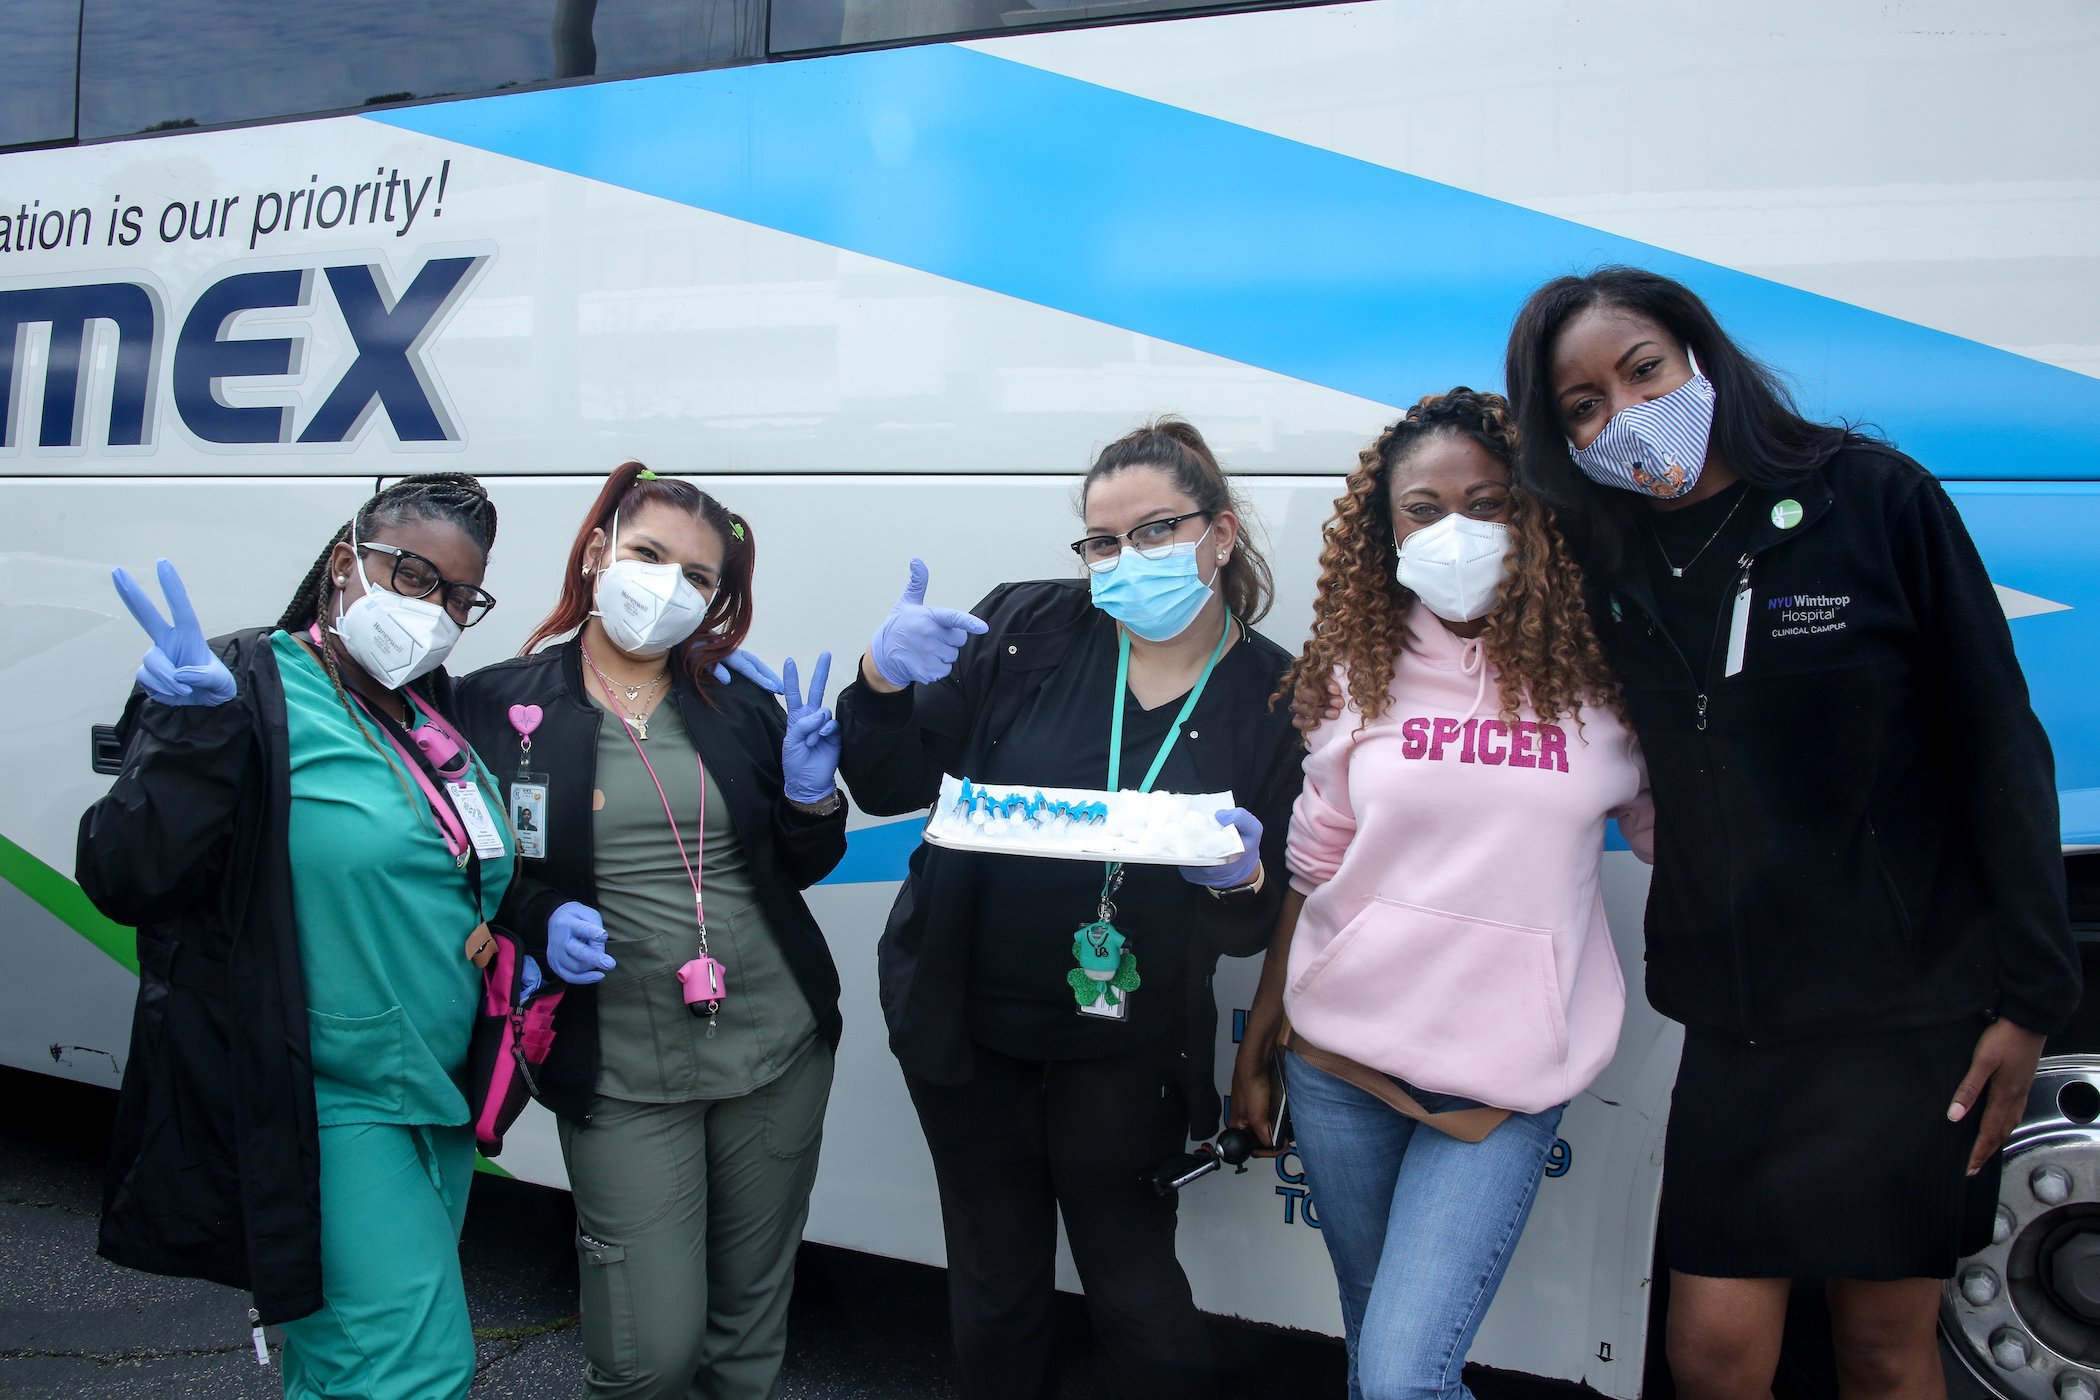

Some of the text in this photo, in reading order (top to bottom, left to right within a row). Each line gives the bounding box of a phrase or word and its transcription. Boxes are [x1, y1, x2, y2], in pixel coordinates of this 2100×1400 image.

[107, 194, 144, 247] is
[159, 195, 240, 243] our
[249, 159, 451, 250] priority!
[621, 590, 648, 613] Honeywell
[1768, 595, 1850, 609] NYU Winthrop
[1782, 608, 1834, 623] Hospital
[373, 621, 403, 654] Honeywell
[1772, 622, 1846, 637] CLINICAL CAMPUS
[1401, 717, 1570, 773] SPICER
